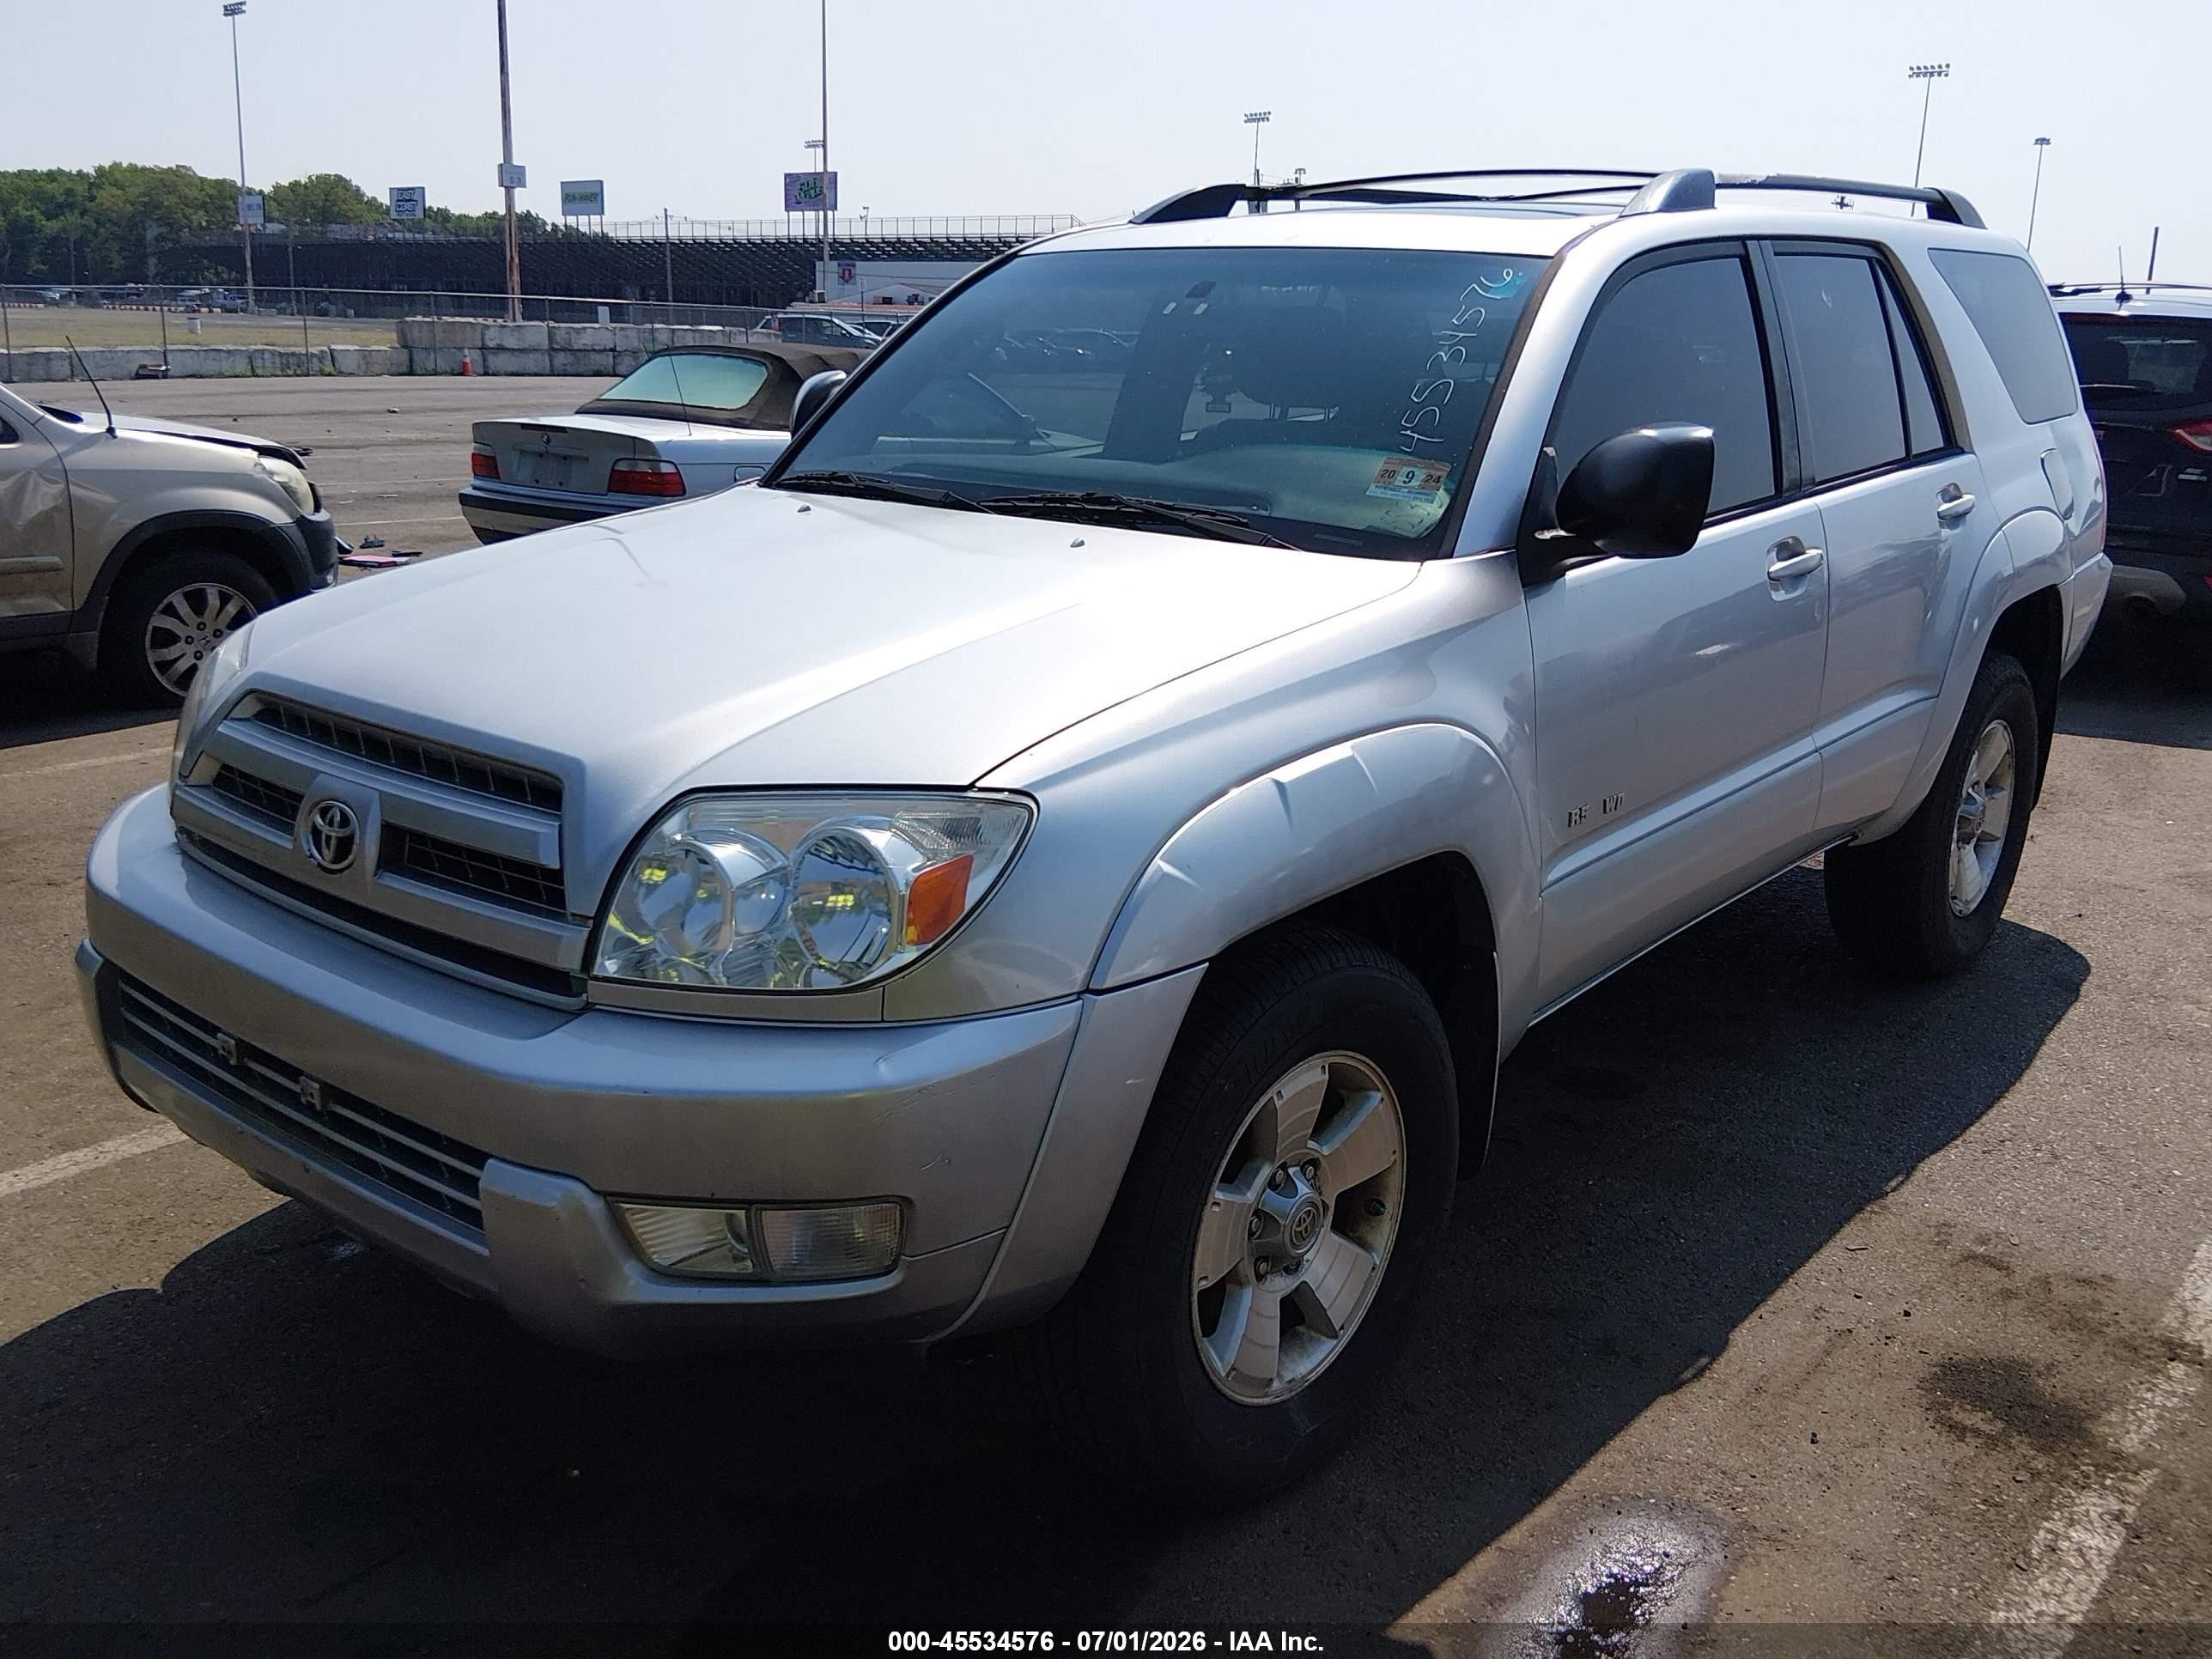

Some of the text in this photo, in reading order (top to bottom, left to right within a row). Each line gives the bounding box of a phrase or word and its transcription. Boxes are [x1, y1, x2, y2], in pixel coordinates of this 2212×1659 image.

[398, 190, 416, 200] EAST
[1399, 267, 1514, 453] 45534576
[1379, 469, 1442, 485] 20 9 24
